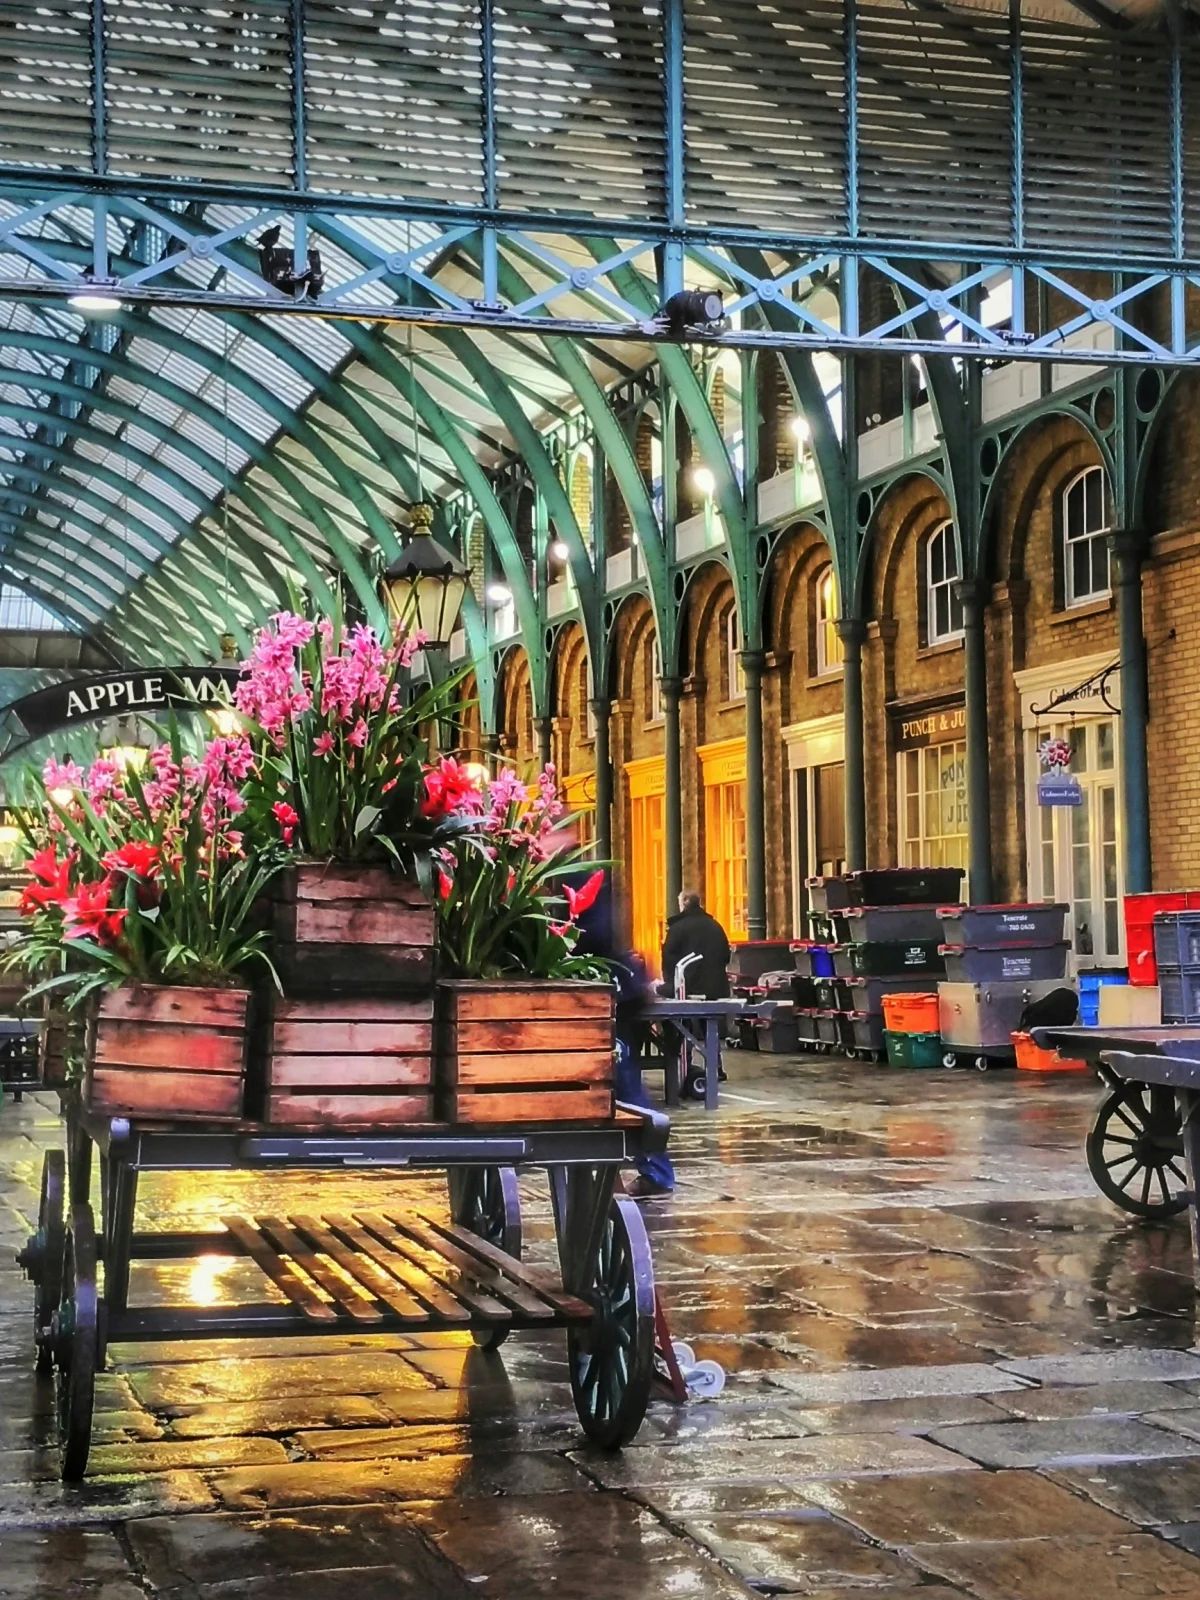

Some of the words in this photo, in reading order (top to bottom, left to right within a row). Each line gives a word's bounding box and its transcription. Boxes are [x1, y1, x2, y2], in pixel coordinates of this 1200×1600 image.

[66, 677, 165, 717] APPLE
[902, 716, 936, 739] PUNCH
[940, 714, 949, 731] &
